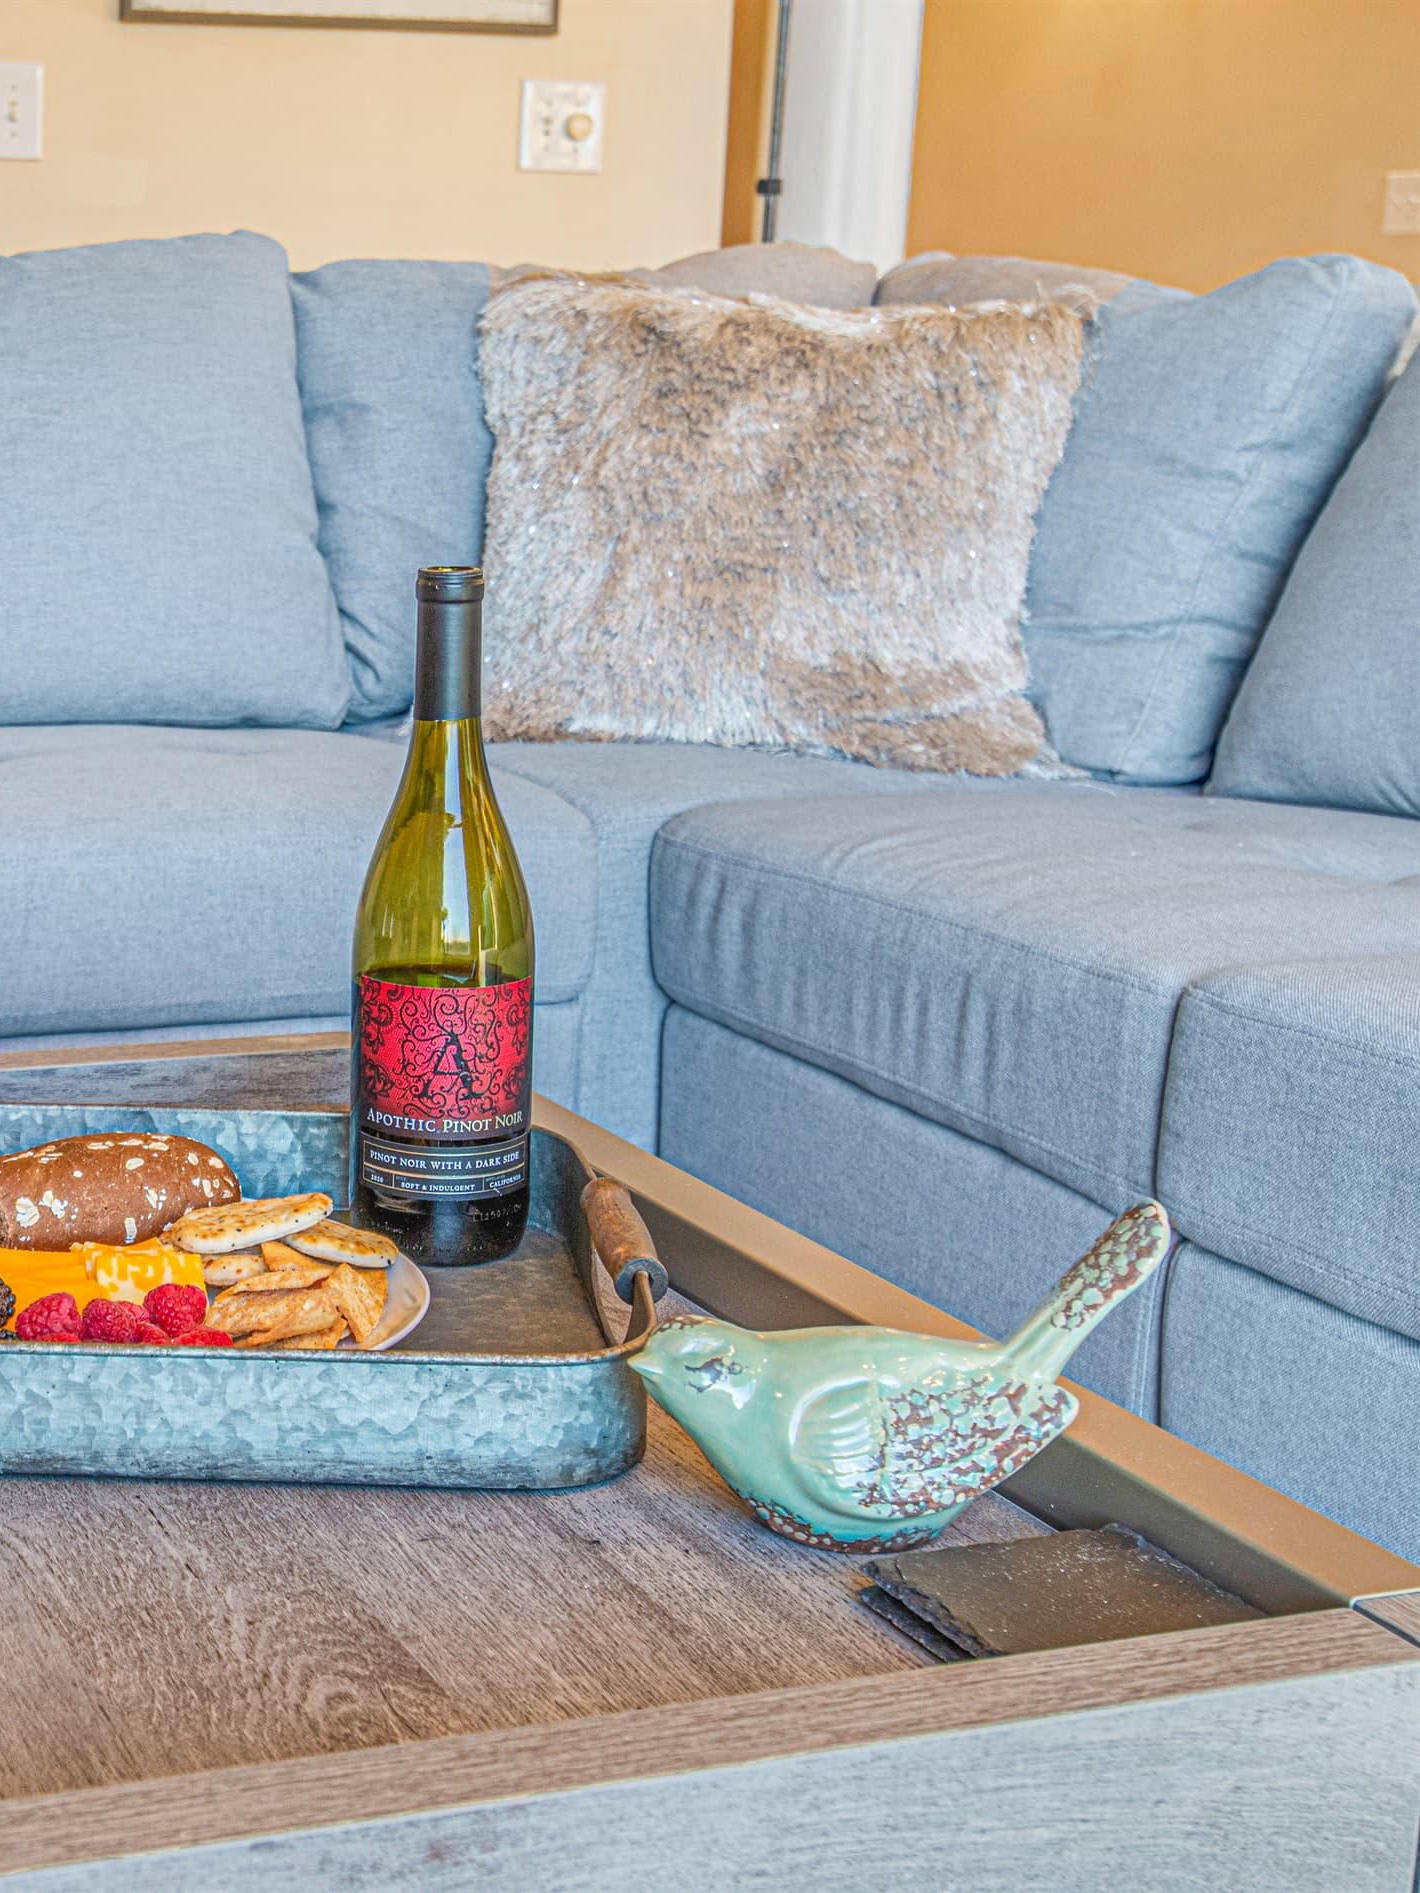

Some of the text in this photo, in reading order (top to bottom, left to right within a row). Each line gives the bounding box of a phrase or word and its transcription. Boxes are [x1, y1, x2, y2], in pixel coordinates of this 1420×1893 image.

[367, 1107, 523, 1133] APOTHIC PINOT NOIR
[370, 1149, 520, 1170] PINOT NOIR WITH A DARK SIDE
[400, 1181, 420, 1190] SOFT
[429, 1184, 476, 1192] INDULGENT
[489, 1173, 521, 1188] CALIFORNIA
